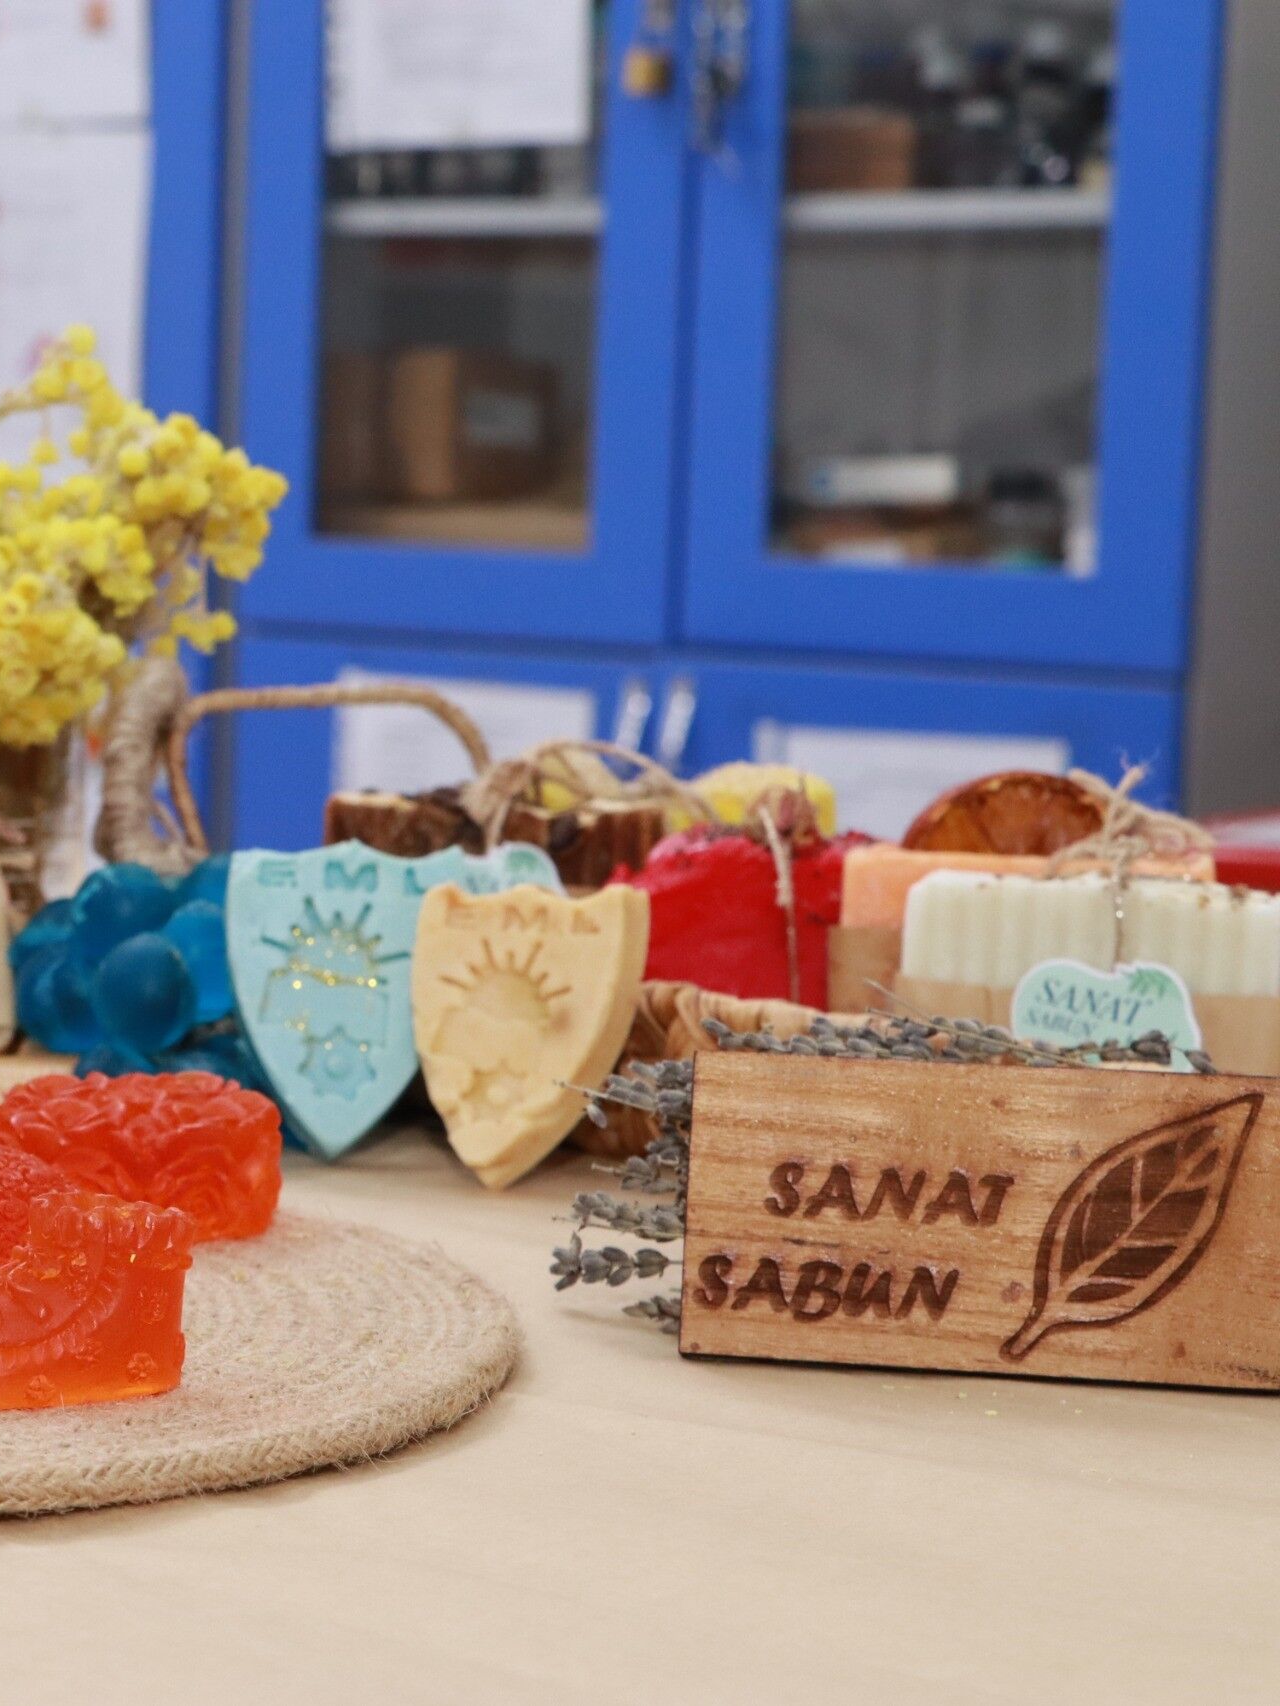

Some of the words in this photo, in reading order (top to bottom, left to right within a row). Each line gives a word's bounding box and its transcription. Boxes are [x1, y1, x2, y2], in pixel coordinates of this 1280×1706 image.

[445, 904, 601, 934] EML
[1036, 977, 1153, 1026] SANAT
[764, 1161, 1015, 1227] SANAT
[693, 1253, 961, 1323] SABUN
